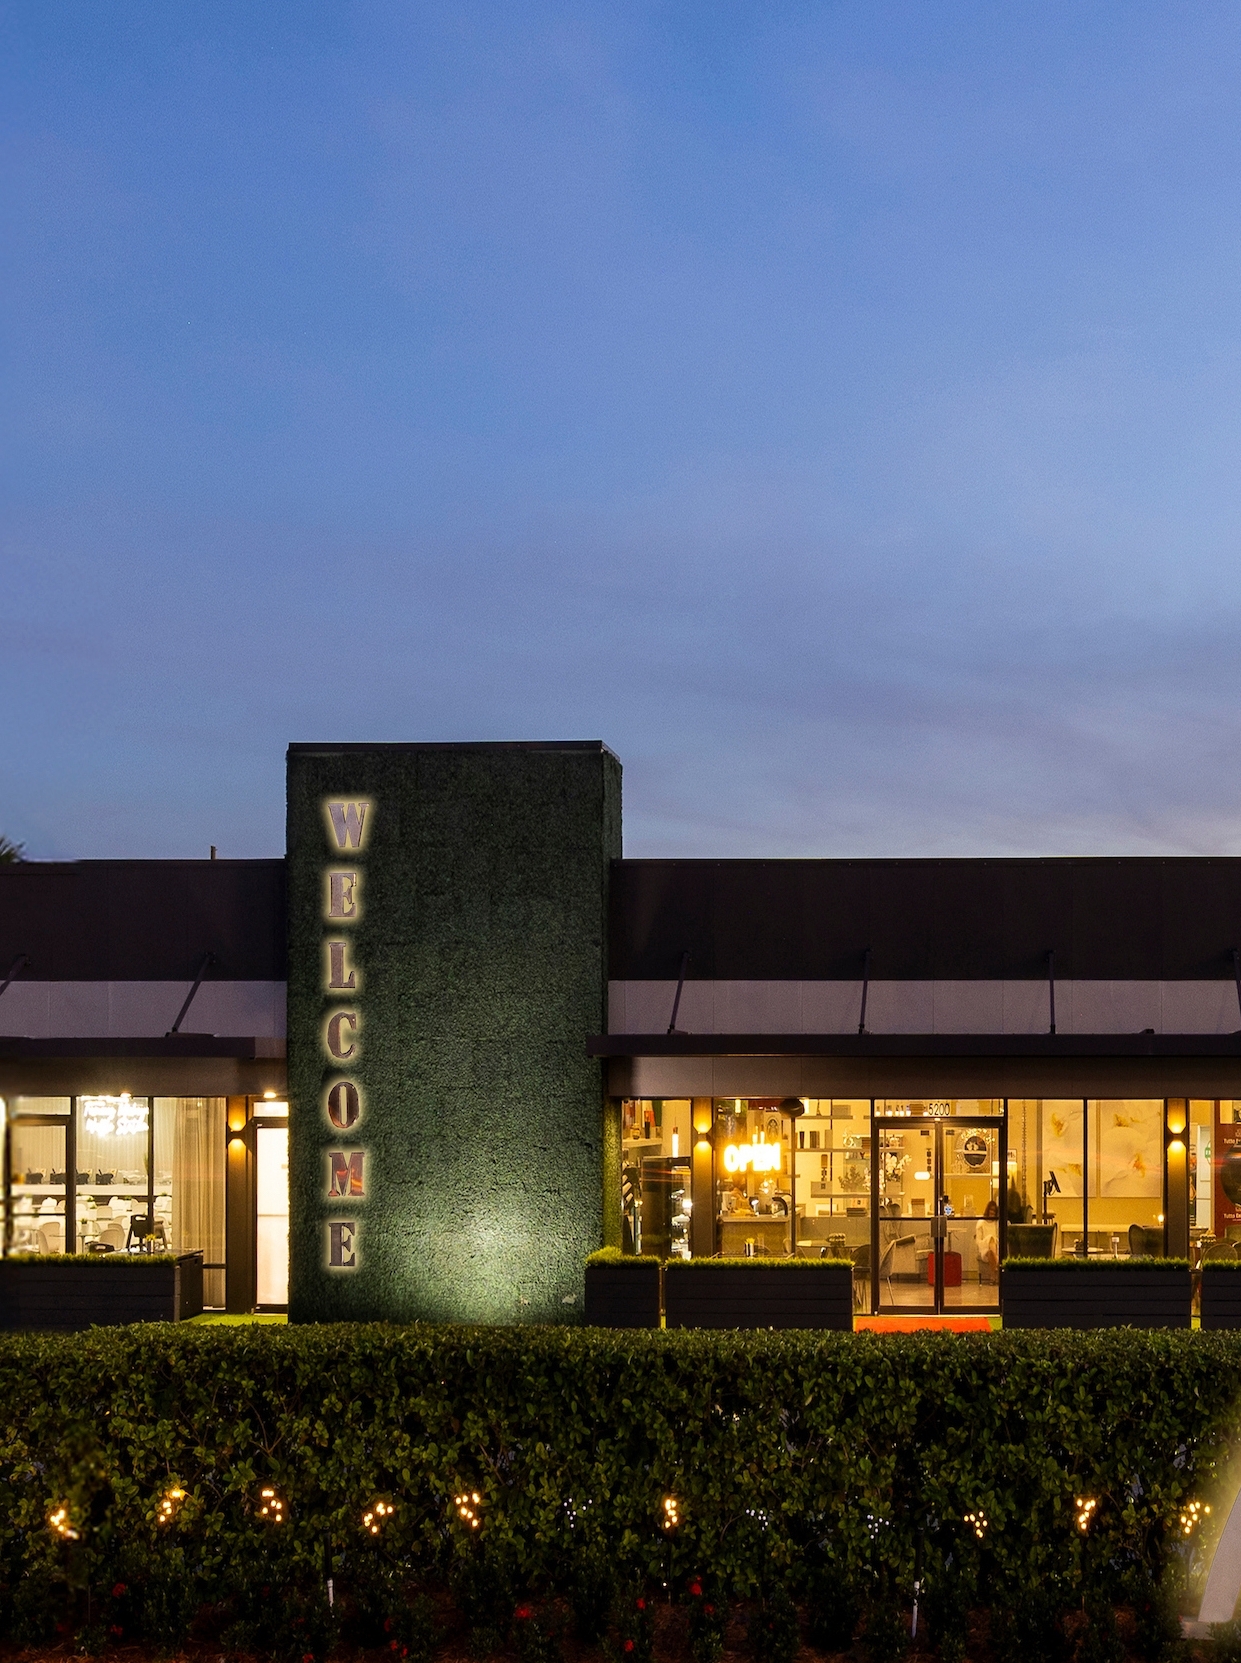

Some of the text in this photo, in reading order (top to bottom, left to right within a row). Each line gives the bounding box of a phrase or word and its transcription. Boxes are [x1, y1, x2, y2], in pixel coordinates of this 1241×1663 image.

[328, 801, 369, 1268] WELCOME
[928, 1103, 951, 1116] 5200
[724, 1143, 781, 1172] OPEN
